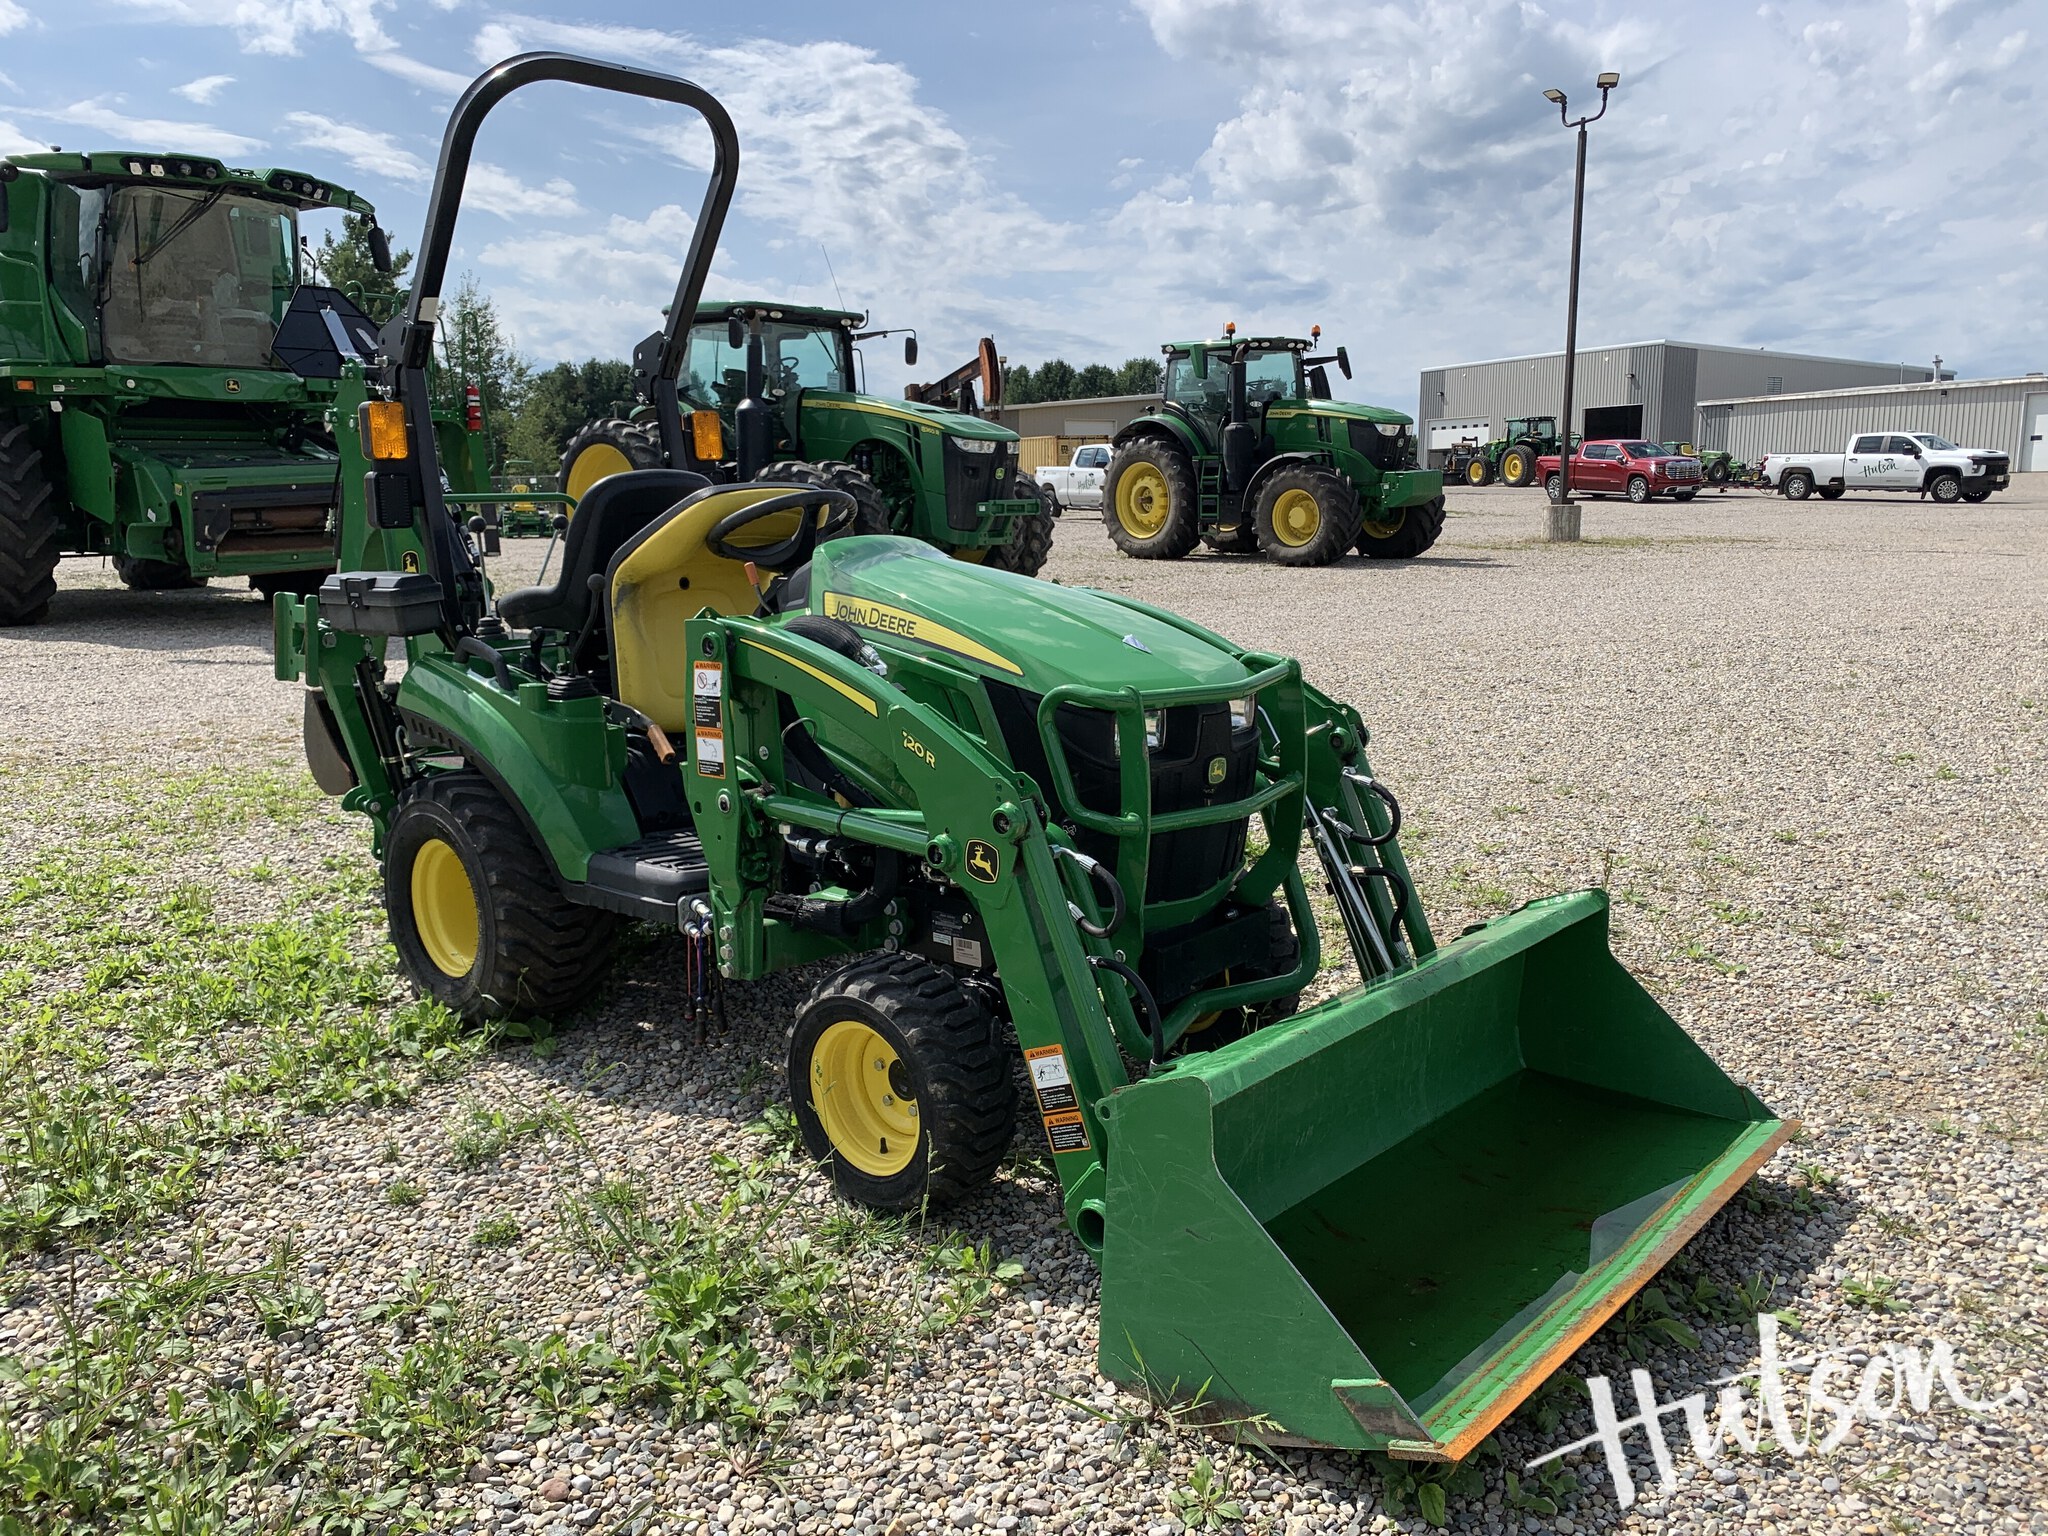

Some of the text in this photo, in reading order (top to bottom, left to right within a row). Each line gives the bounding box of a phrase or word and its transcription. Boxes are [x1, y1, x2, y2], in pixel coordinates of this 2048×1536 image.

[1858, 460, 1900, 477] Hutson
[831, 600, 917, 636] JOHN DEERE
[699, 662, 721, 670] WARNING
[1035, 1047, 1059, 1057] WARNING
[1055, 1115, 1079, 1124] WARNING
